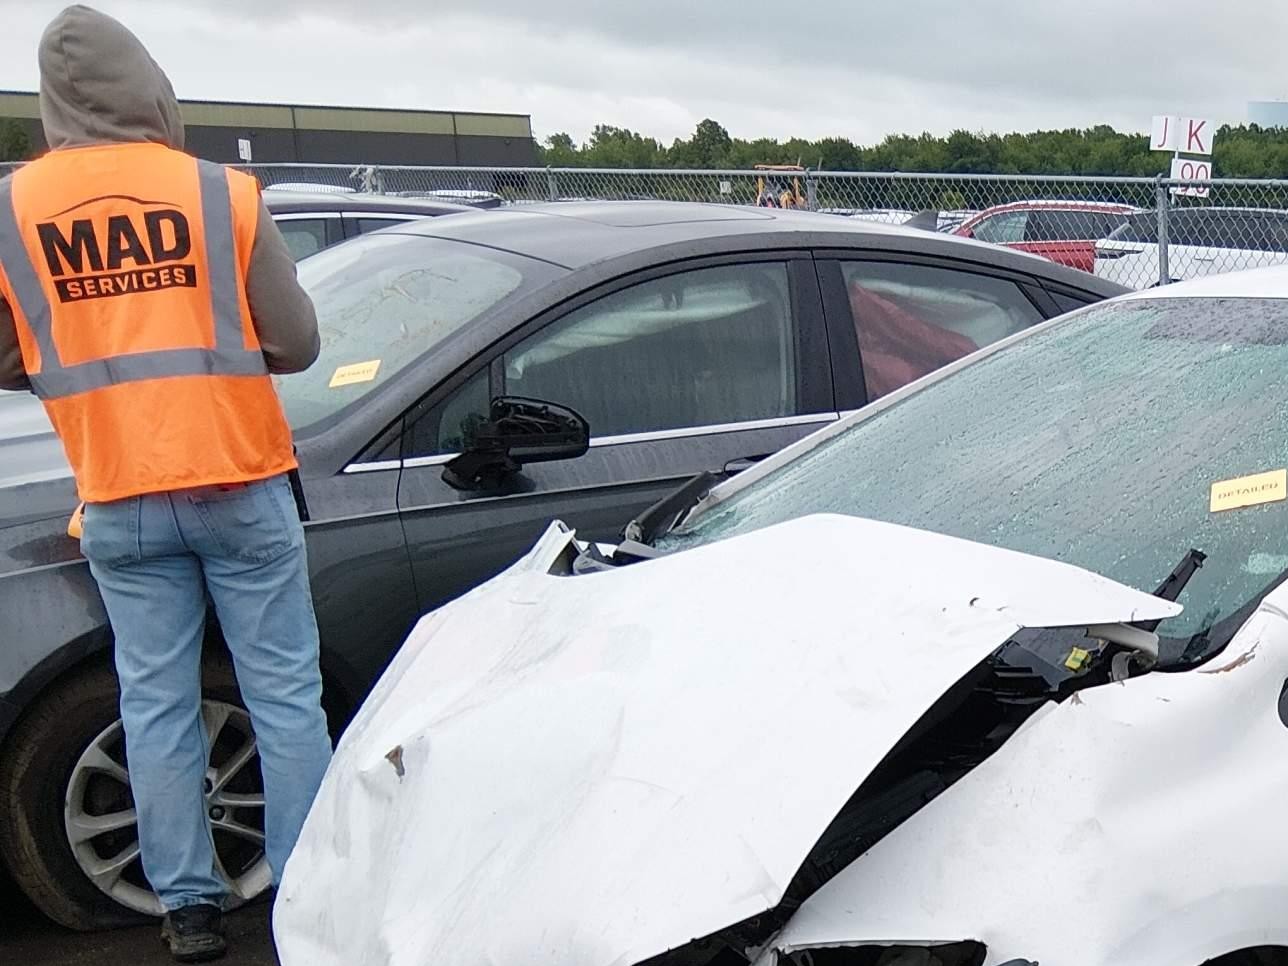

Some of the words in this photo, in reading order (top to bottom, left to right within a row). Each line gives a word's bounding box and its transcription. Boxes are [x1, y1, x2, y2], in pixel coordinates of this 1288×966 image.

[1187, 119, 1207, 152] K
[36, 209, 192, 277] MAD
[65, 267, 187, 298] SERVICES
